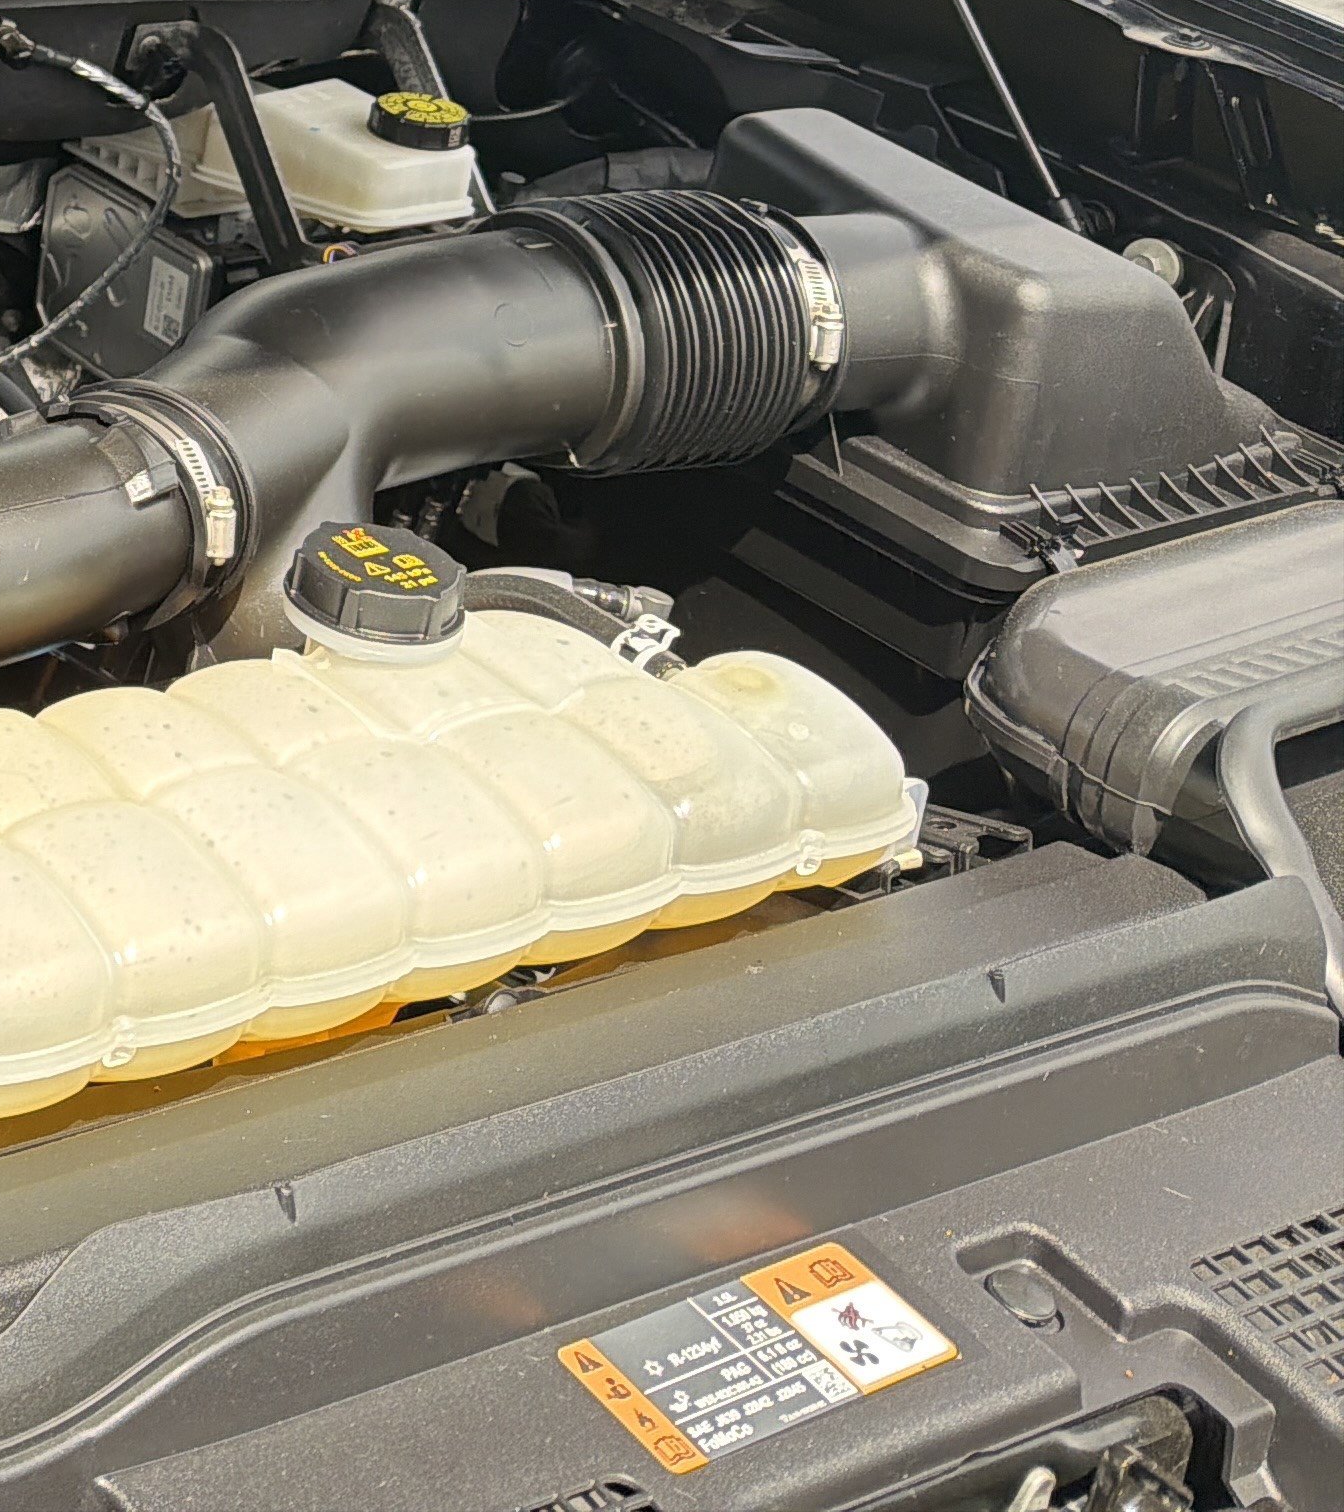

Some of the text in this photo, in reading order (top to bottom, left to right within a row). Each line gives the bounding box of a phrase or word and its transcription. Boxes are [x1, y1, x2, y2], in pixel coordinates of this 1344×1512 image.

[718, 1360, 755, 1382] PAG
[683, 1419, 717, 1439] SAE
[695, 1420, 758, 1453] FoMoCo
